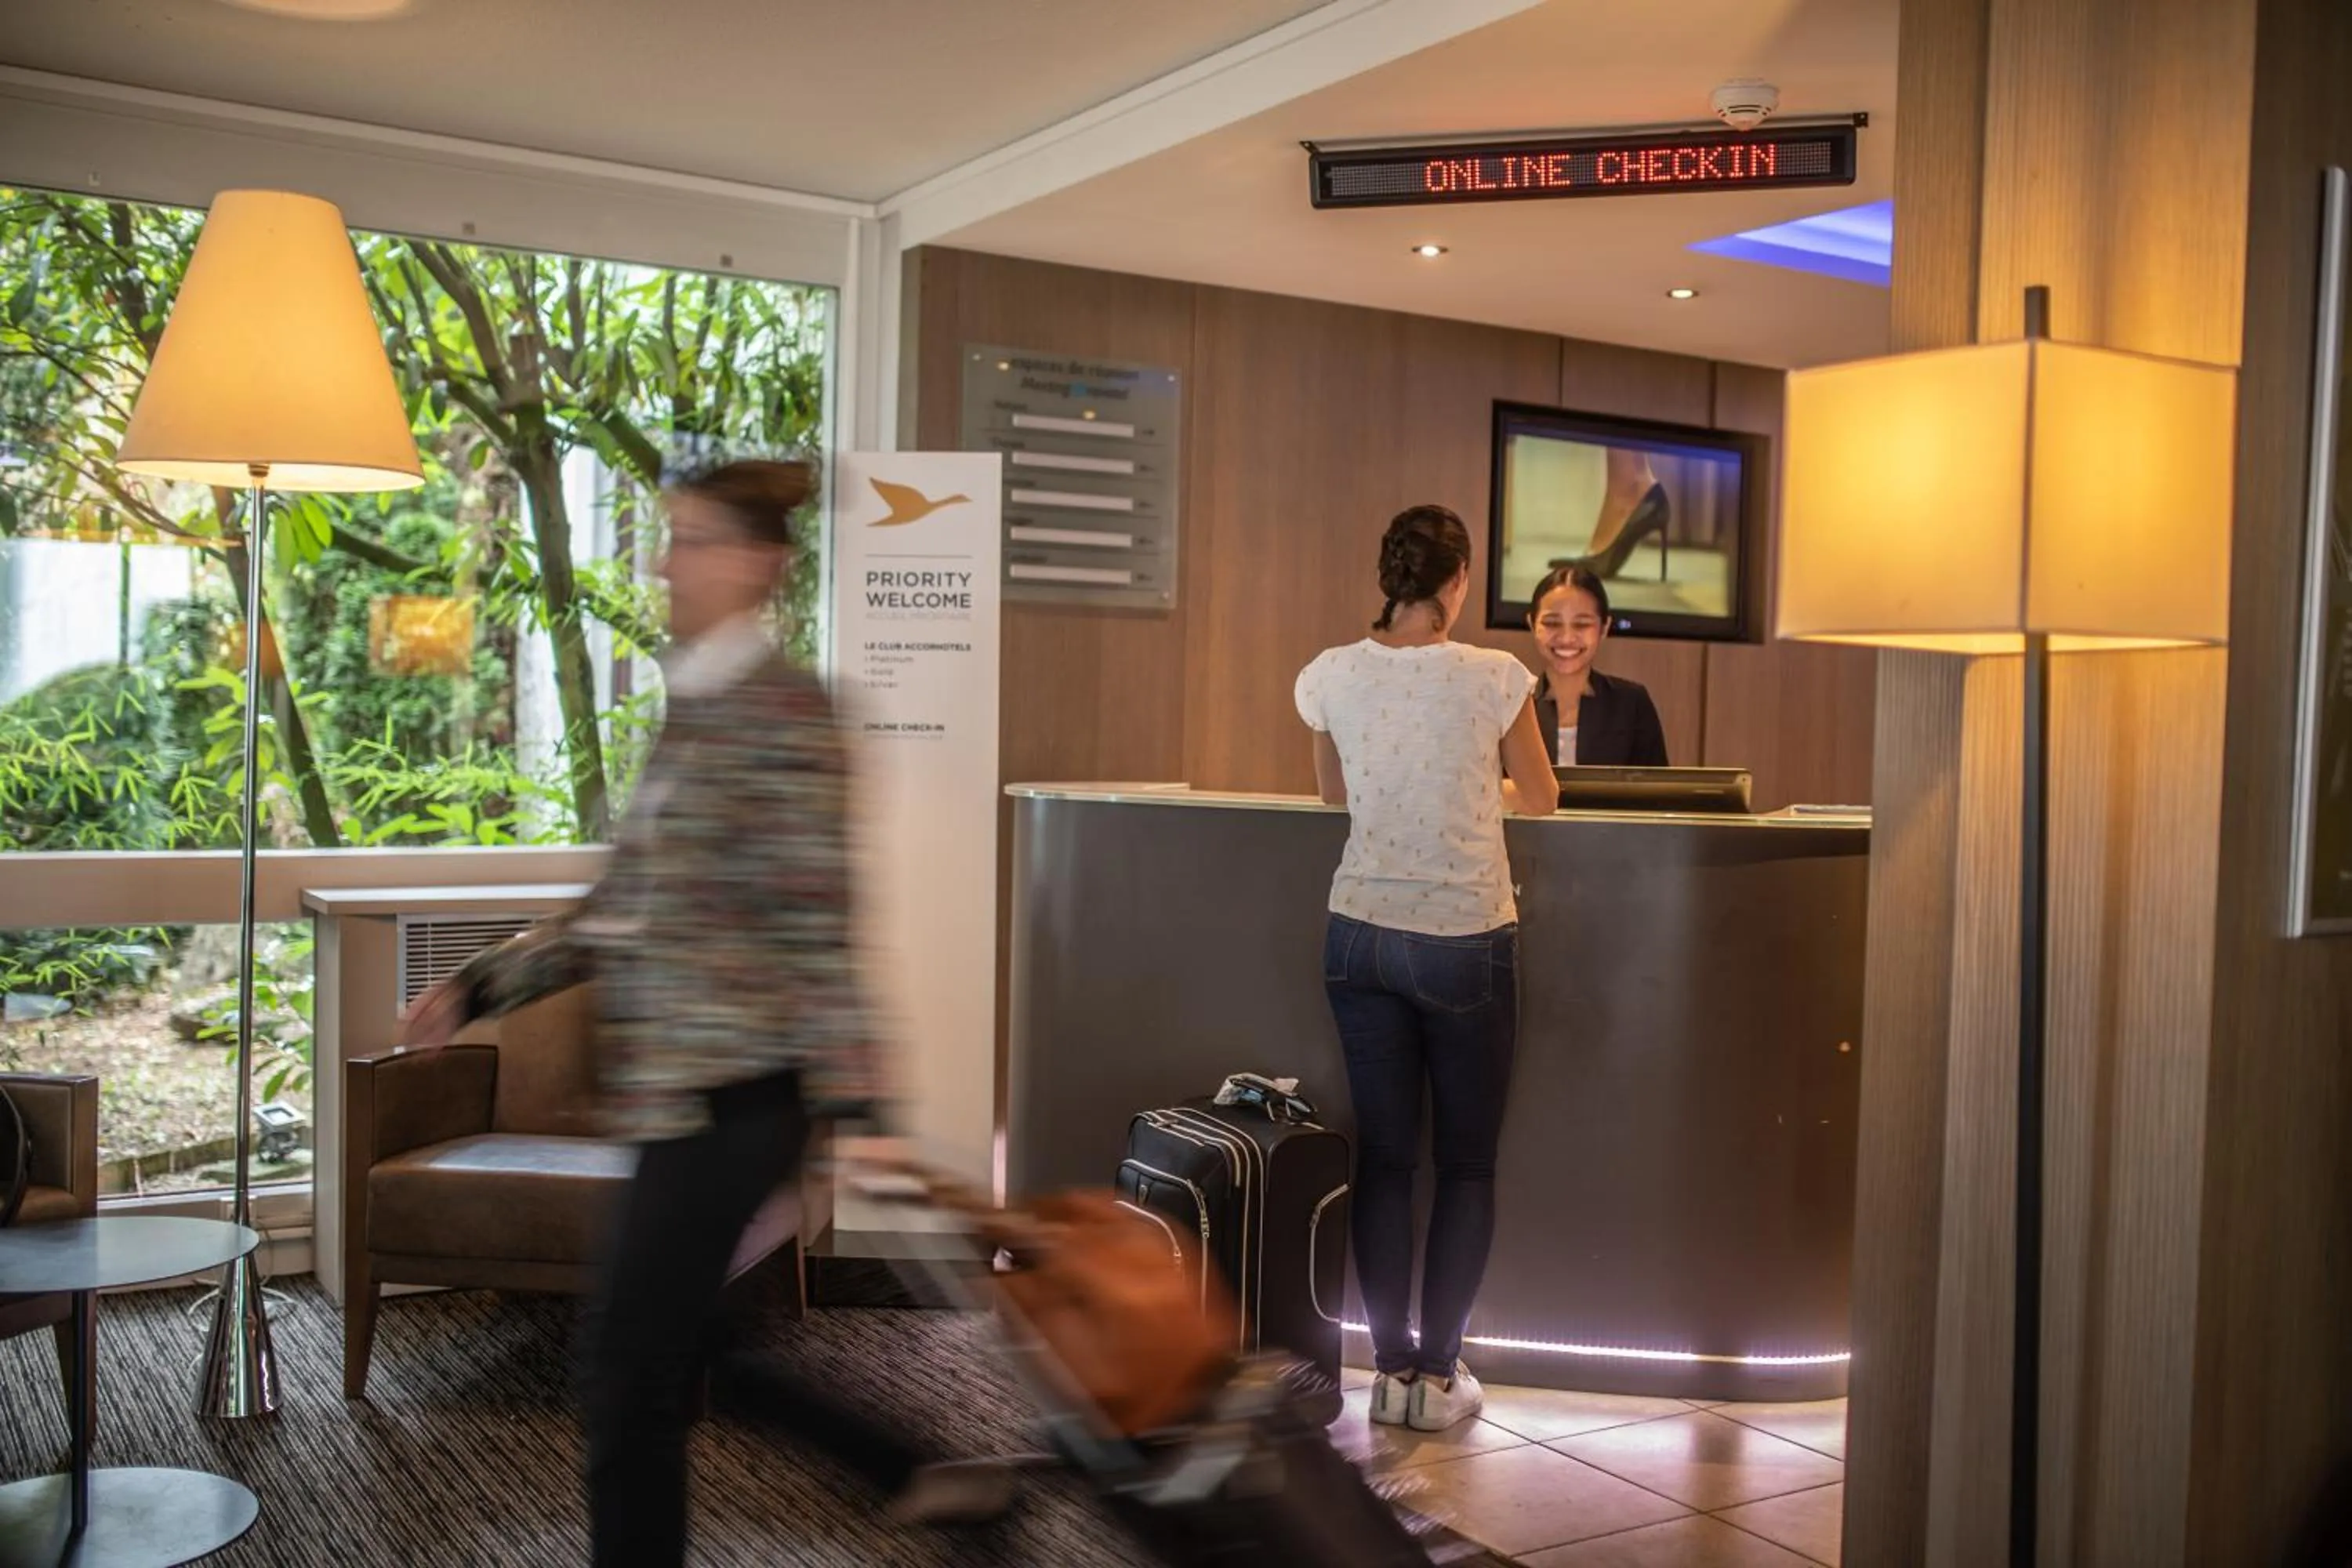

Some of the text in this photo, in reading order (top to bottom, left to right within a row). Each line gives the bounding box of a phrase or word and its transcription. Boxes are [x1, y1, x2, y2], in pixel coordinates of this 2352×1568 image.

[1425, 143, 1777, 193] ONLINE CHECKIN
[866, 571, 972, 588] PRIORITY
[866, 591, 972, 608] WELCOME
[865, 641, 876, 651] LE
[878, 642, 902, 652] CLUB
[864, 722, 945, 732] ONLINE CHECK-IN
